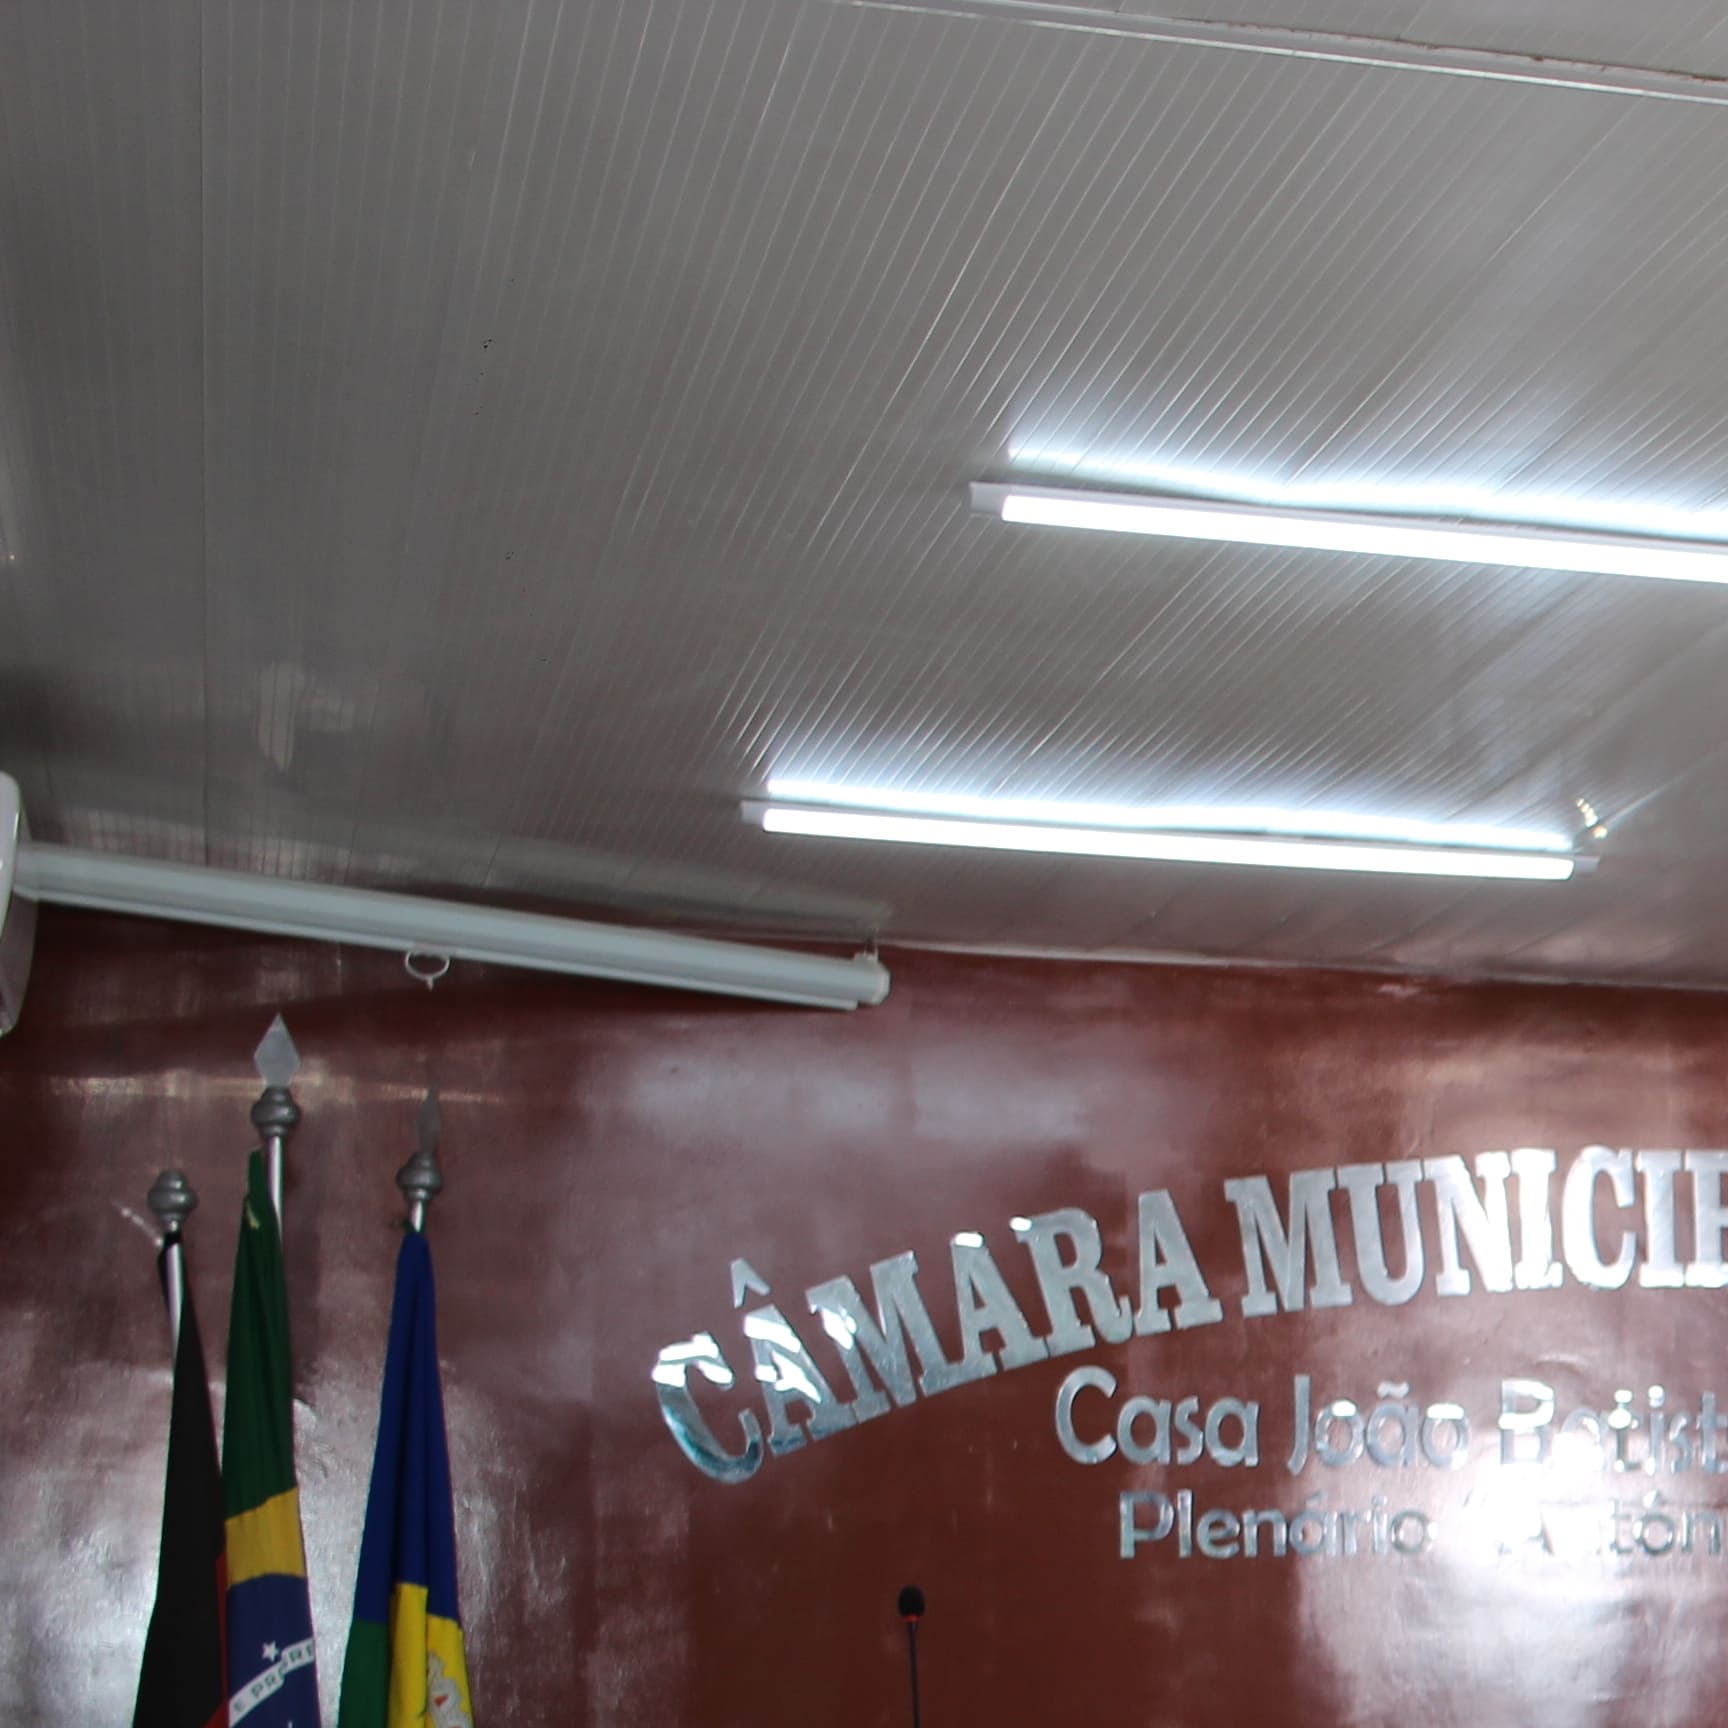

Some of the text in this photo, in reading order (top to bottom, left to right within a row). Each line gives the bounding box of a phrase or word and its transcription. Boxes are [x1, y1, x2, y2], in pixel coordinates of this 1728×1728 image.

[651, 1192, 1222, 1485] CÂMARA
[1054, 1365, 1261, 1467] Casa
[1286, 1373, 1471, 1476] João
[1119, 1489, 1440, 1560] Plenário
